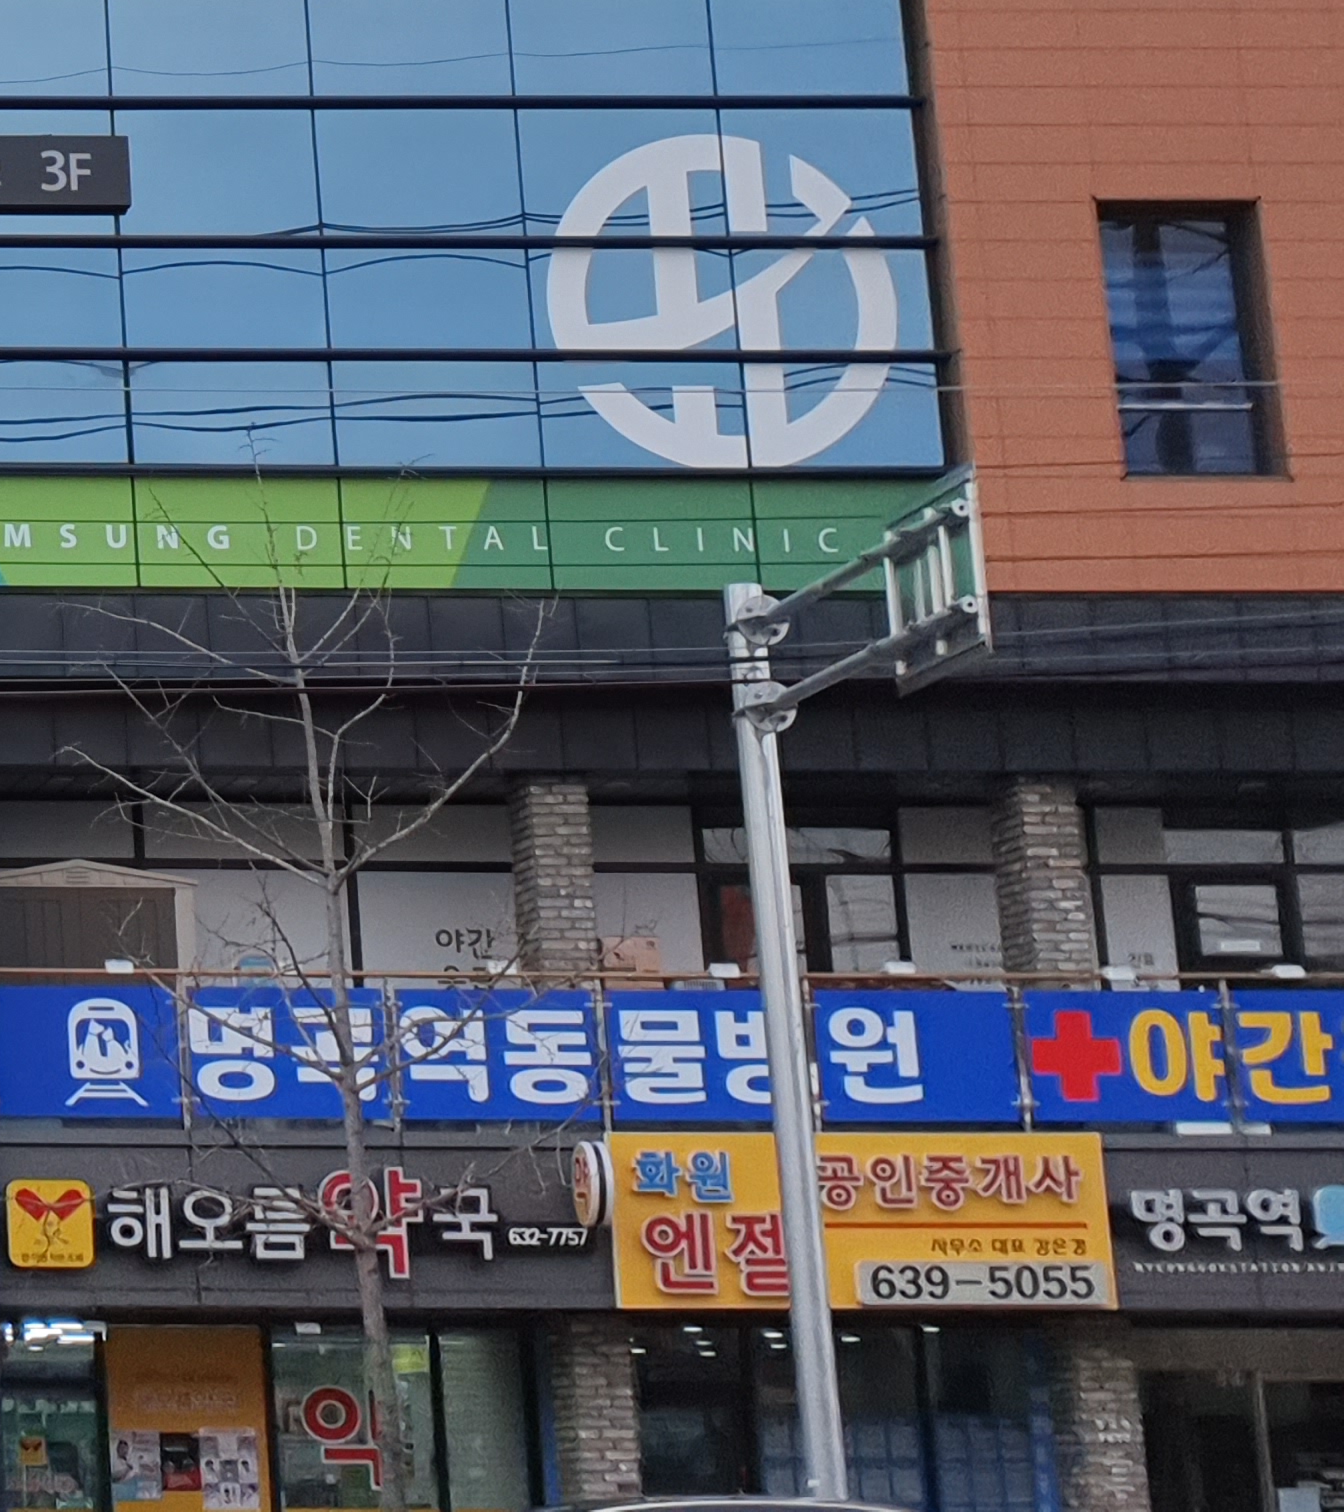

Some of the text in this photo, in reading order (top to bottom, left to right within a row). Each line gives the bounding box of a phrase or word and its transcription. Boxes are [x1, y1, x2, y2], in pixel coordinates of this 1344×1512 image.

[40, 149, 92, 192] 3F
[294, 523, 550, 553] DENTAL
[605, 524, 842, 554] CLINIC
[435, 928, 496, 960] 야간
[188, 1005, 924, 1106] 명곡역동물병원
[1126, 1007, 1334, 1104] 야간
[632, 1150, 1082, 1212] 화원 공인중개사
[1129, 1187, 1304, 1252] 명곡역
[869, 1264, 1096, 1300] 639-5055
